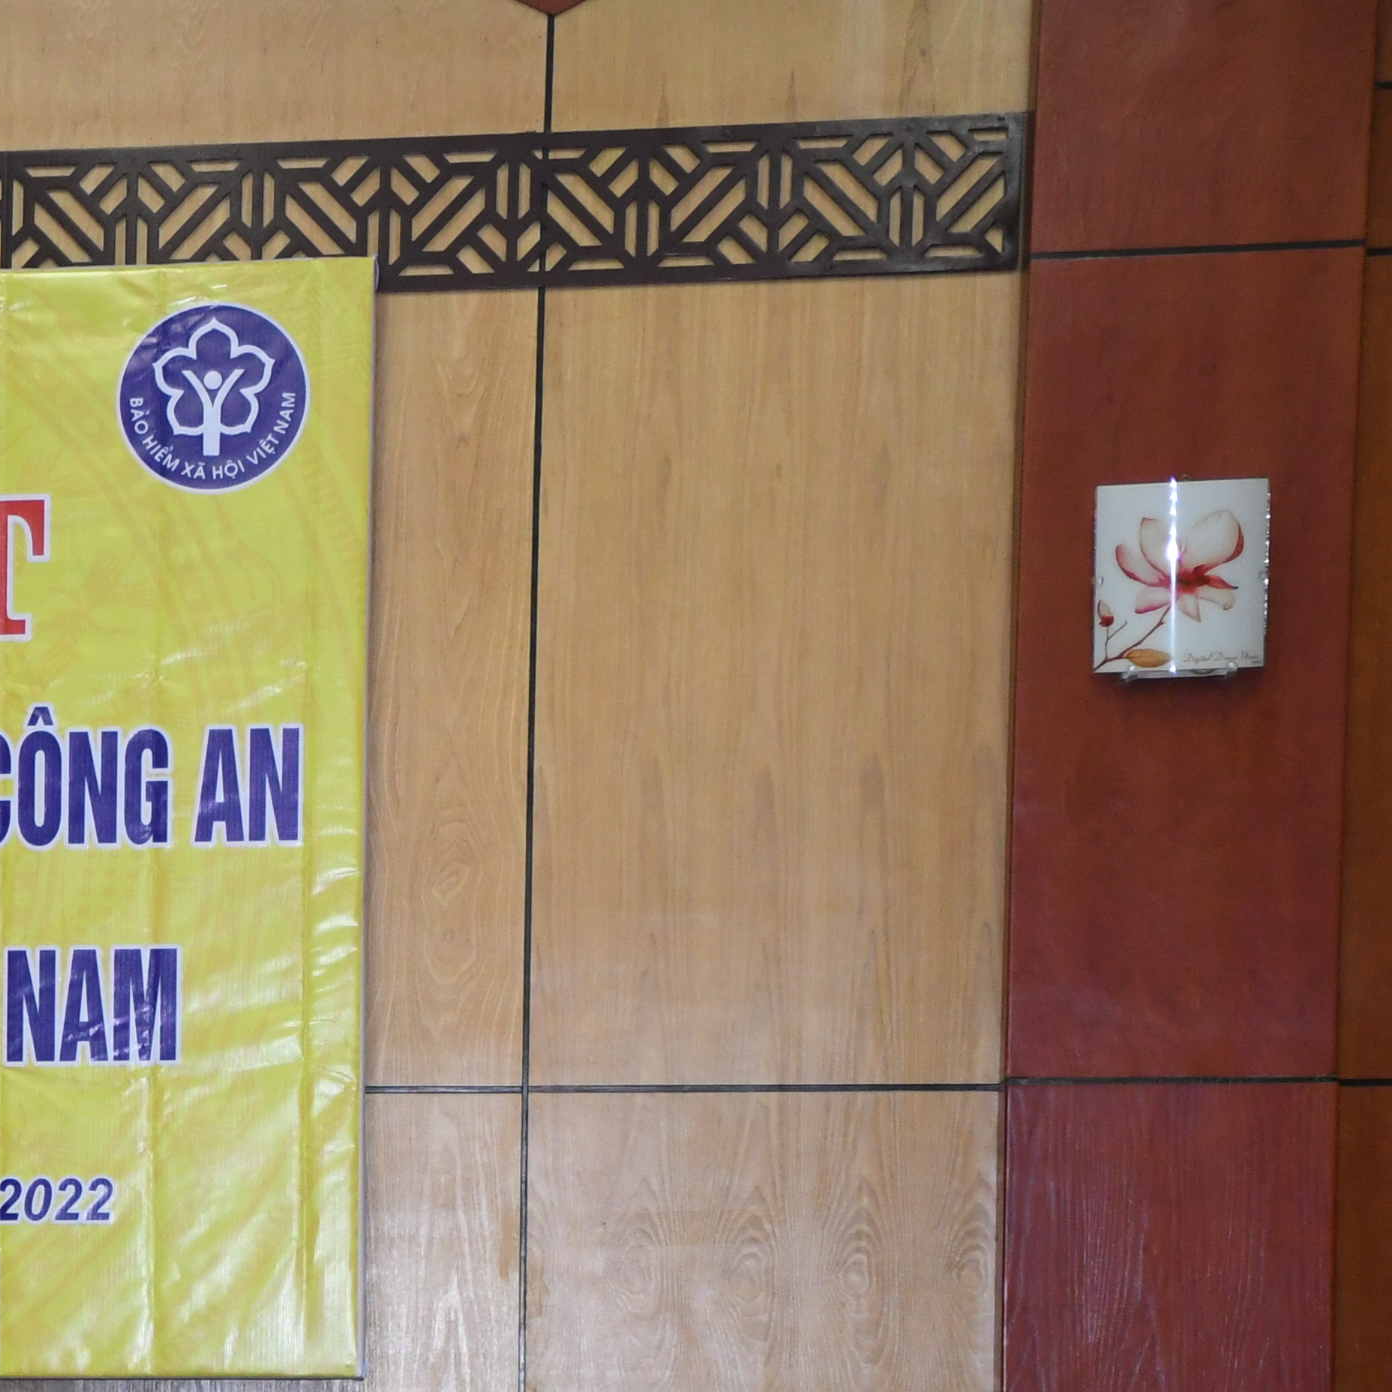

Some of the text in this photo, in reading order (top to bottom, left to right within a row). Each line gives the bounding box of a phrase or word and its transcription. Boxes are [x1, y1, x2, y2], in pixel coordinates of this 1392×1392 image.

[129, 392, 296, 480] BẢO HIỂM XÃ HỘI VIỆT NAM
[194, 727, 300, 843] AN
[6, 948, 178, 1063] NAM
